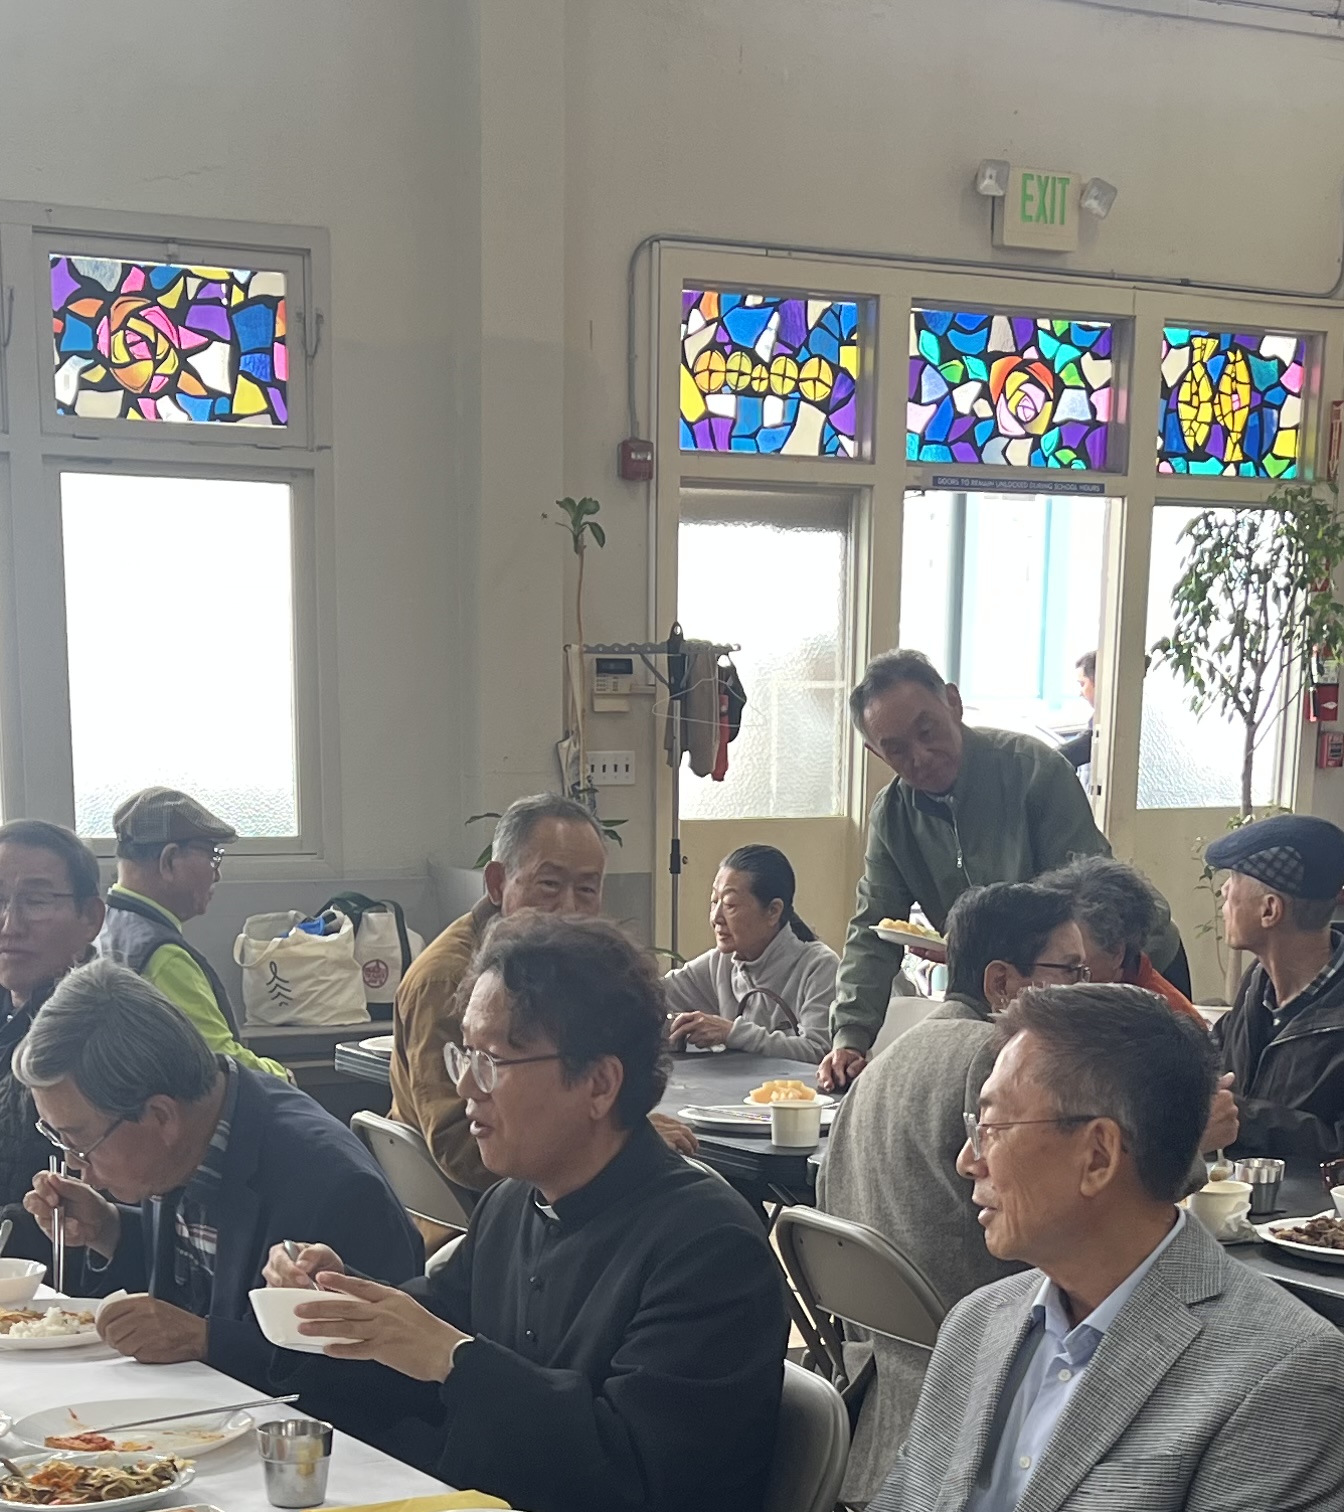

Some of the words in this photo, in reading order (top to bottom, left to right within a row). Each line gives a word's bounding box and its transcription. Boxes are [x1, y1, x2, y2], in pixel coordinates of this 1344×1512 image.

[1021, 172, 1071, 225] EXIT
[937, 477, 959, 486] DOORS
[961, 478, 970, 486] TO
[970, 479, 995, 487] REMAIN
[996, 480, 1029, 489] UNLOCKED
[1029, 482, 1053, 490] DURING
[1054, 483, 1078, 491] SCHOOL
